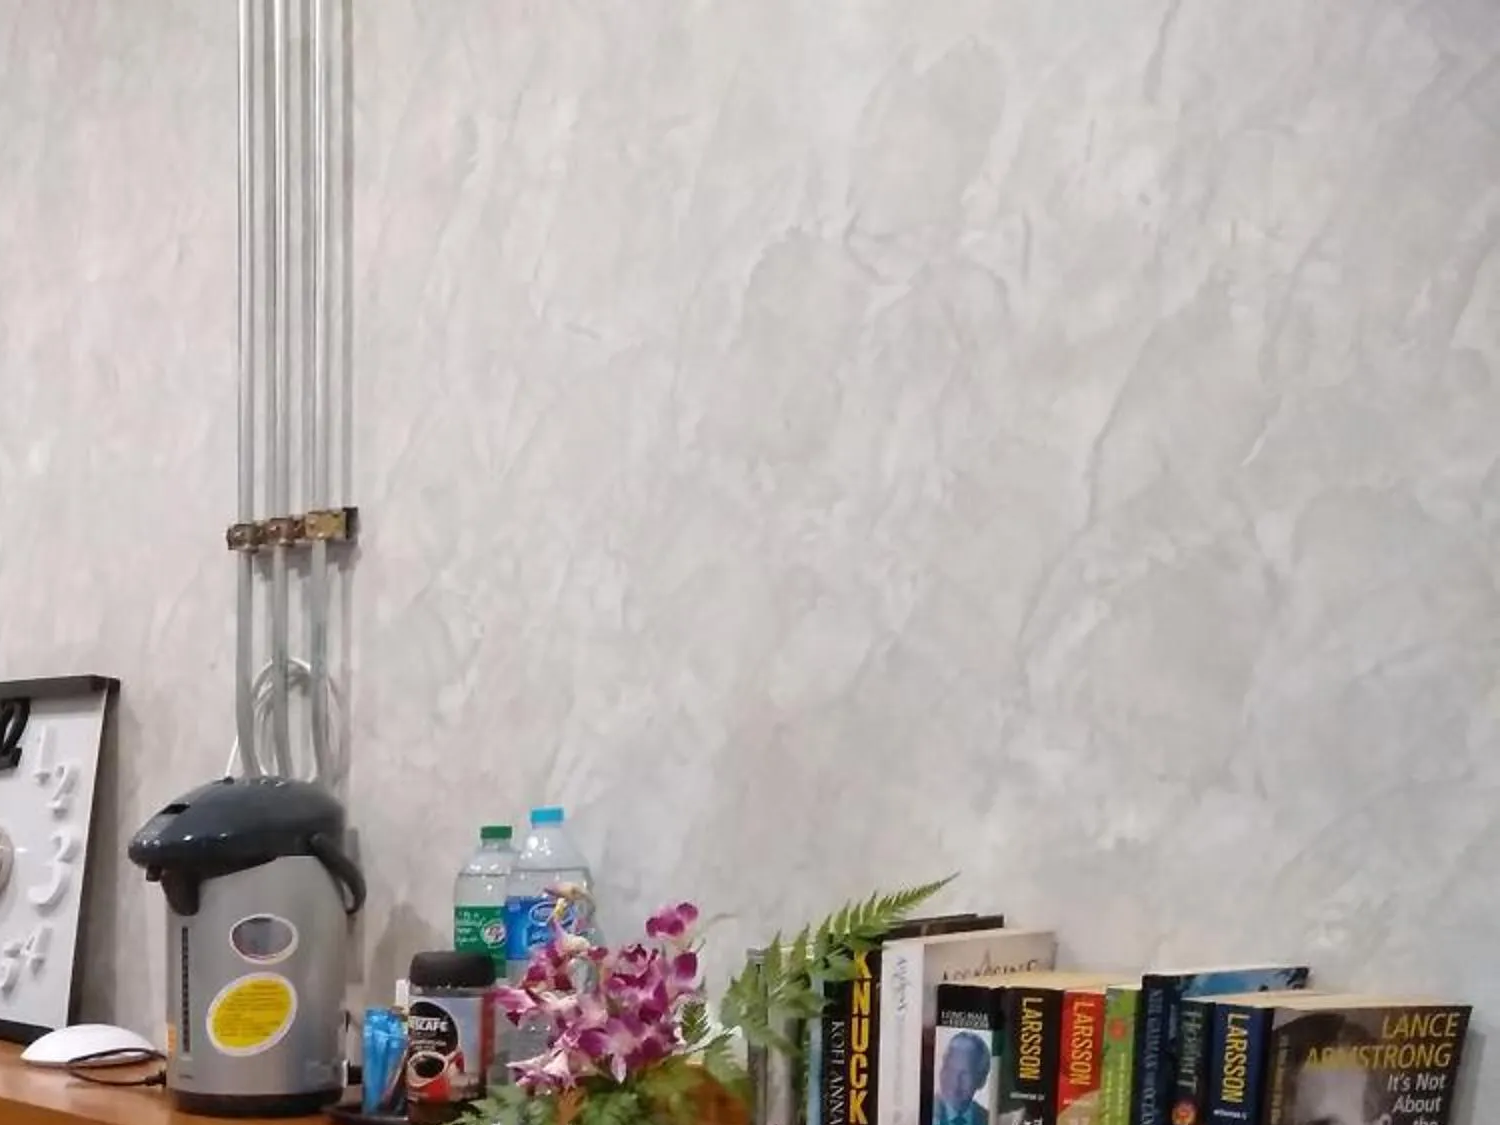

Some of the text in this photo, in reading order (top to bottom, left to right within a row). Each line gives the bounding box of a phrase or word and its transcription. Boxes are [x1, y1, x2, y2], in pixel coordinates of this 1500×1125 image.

[1019, 997, 1043, 1080] LARSSON
[1382, 1012, 1460, 1039] LANCE
[1069, 1001, 1095, 1086] LARSSON
[1304, 1043, 1456, 1070] ARMSTRONG
[1220, 1013, 1250, 1103] LARSSON
[1387, 1073, 1446, 1091] It's Not
[1393, 1095, 1442, 1113] About
